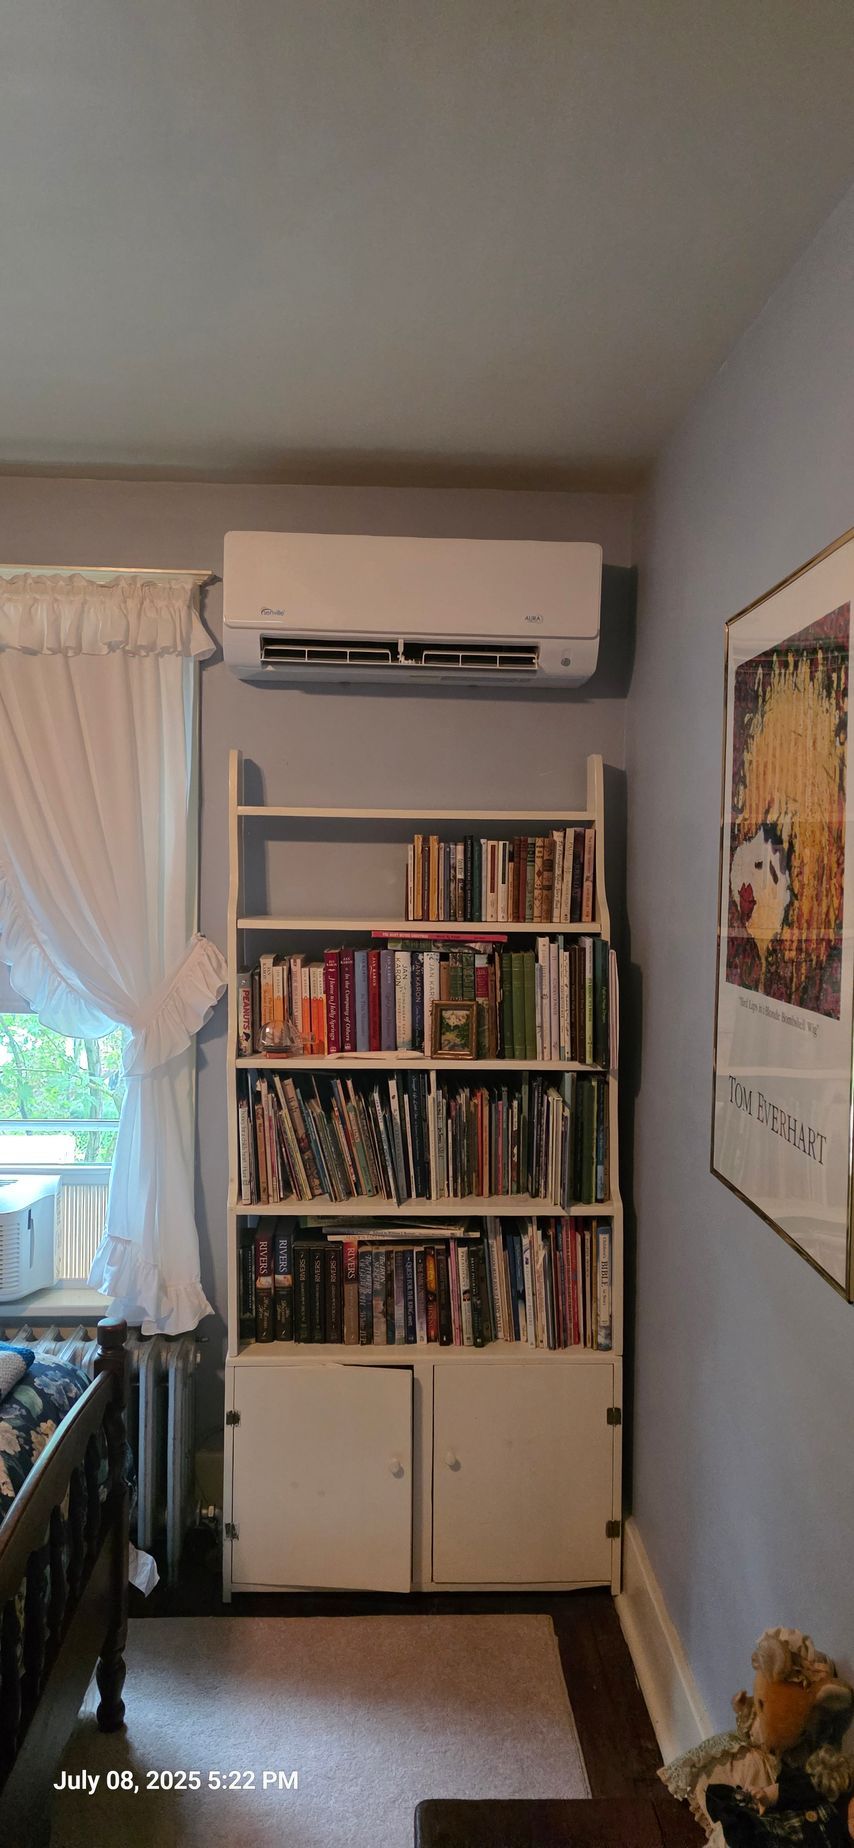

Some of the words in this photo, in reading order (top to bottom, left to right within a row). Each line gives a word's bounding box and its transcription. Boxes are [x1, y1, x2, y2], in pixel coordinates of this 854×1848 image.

[242, 990, 250, 1031] PEANUTS
[729, 1075, 752, 1116] TOM
[757, 1092, 827, 1165] EVERHART
[260, 1242, 268, 1274] RIVERS
[278, 1240, 287, 1272] RIVERS
[600, 1261, 608, 1288] BIBLE
